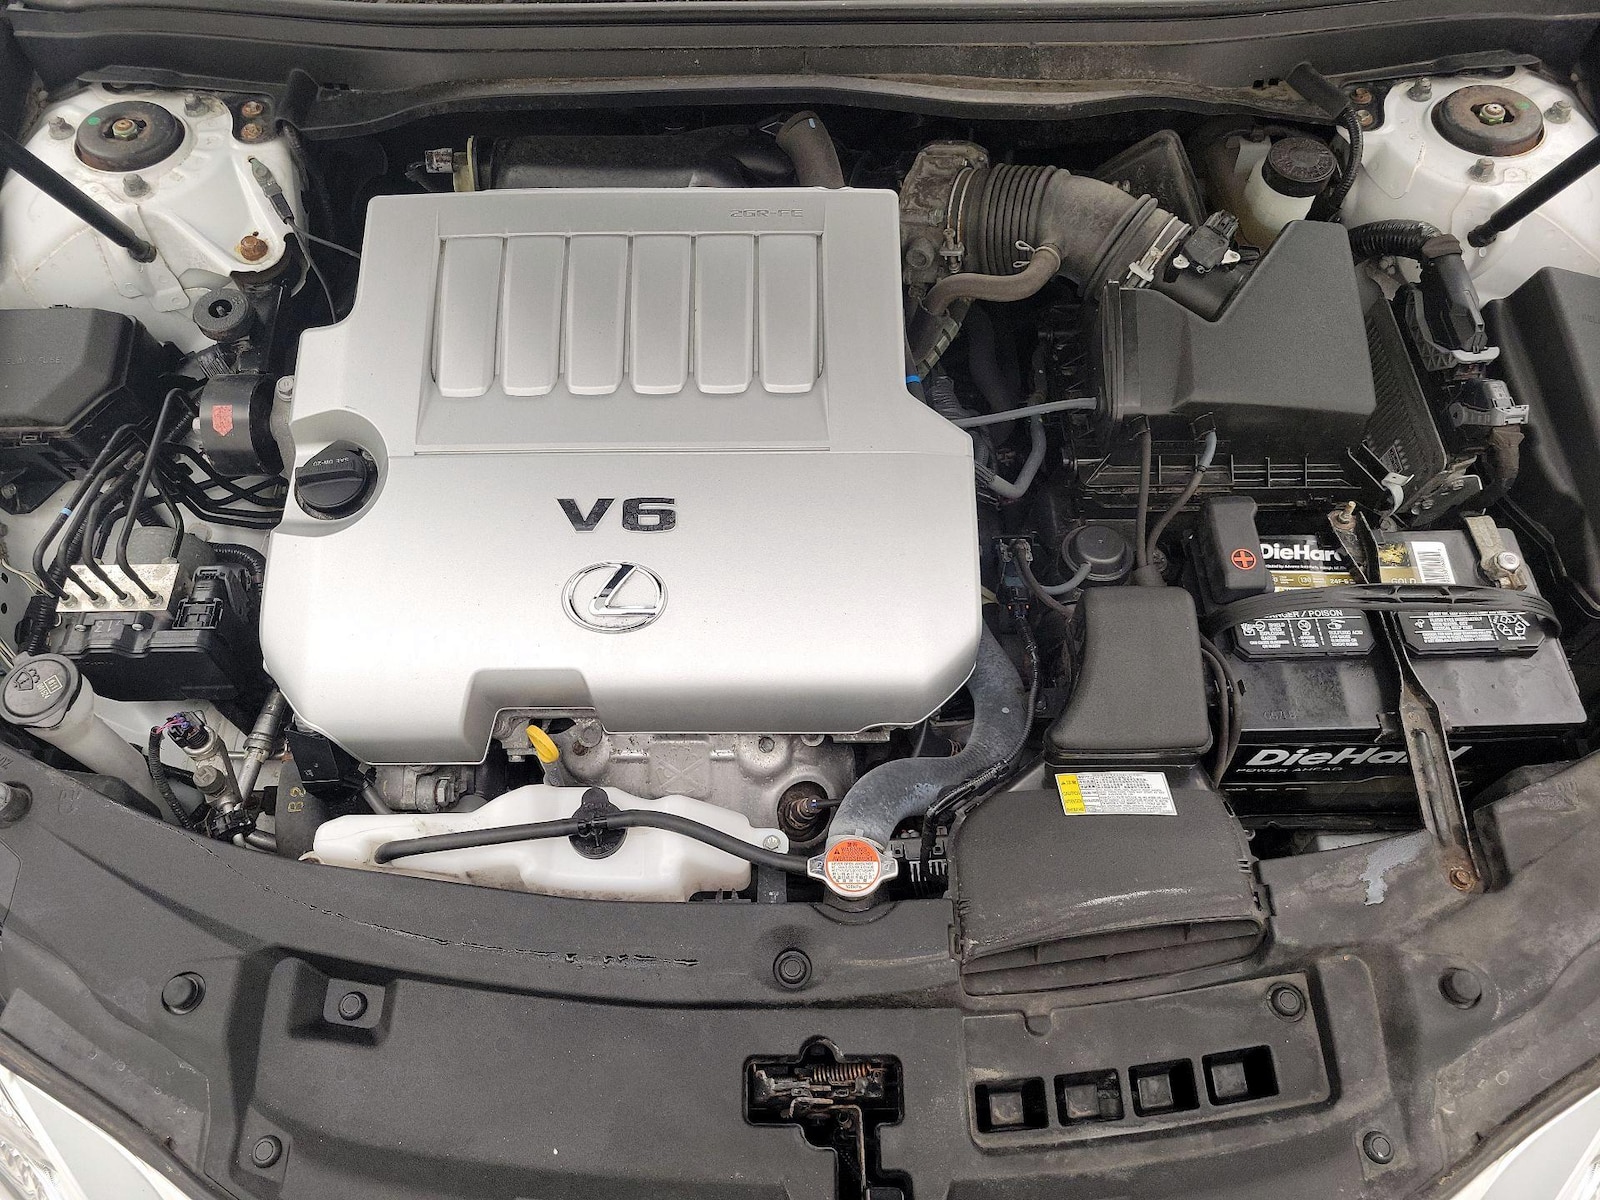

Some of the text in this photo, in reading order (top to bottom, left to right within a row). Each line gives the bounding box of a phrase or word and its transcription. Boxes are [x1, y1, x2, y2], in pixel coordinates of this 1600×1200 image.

[729, 208, 804, 218] 2GR-FE
[556, 497, 677, 533] V6
[1245, 746, 1473, 766] DieHa
